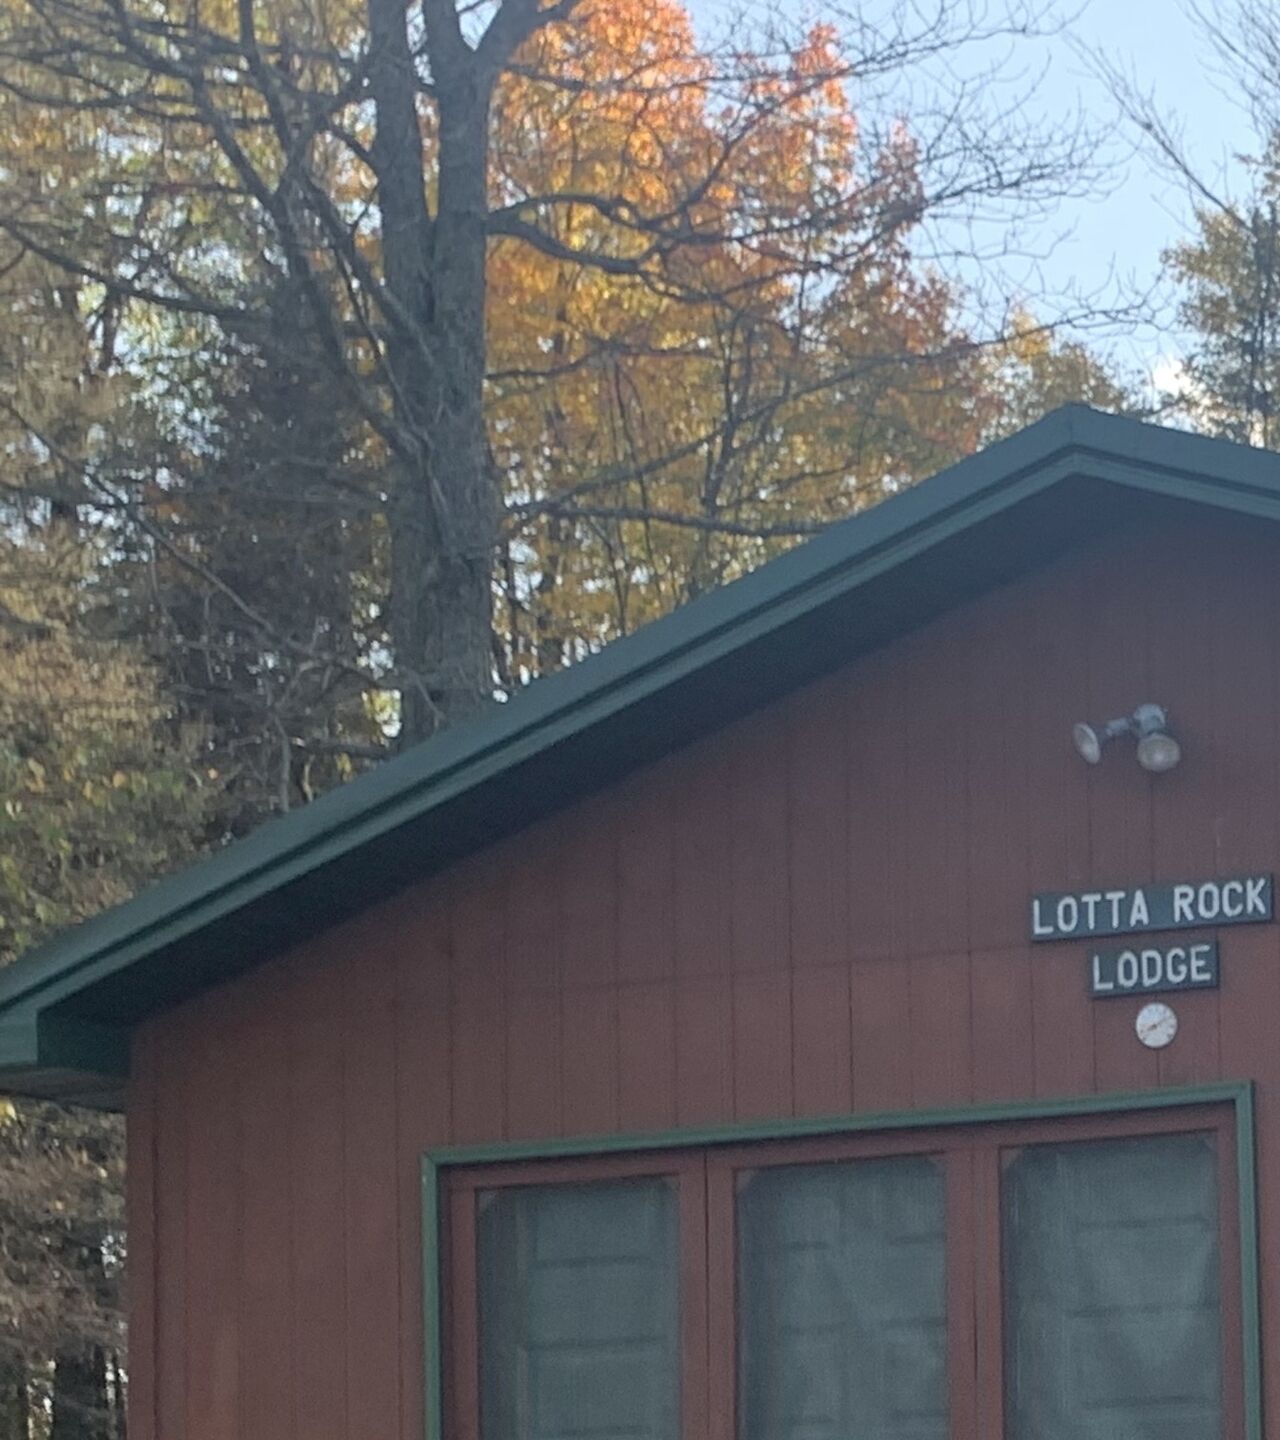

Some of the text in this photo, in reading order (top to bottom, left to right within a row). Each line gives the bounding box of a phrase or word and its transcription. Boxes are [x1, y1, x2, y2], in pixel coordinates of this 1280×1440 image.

[1033, 878, 1266, 934] LOTTA ROCK
[1092, 944, 1211, 990] LODGE
